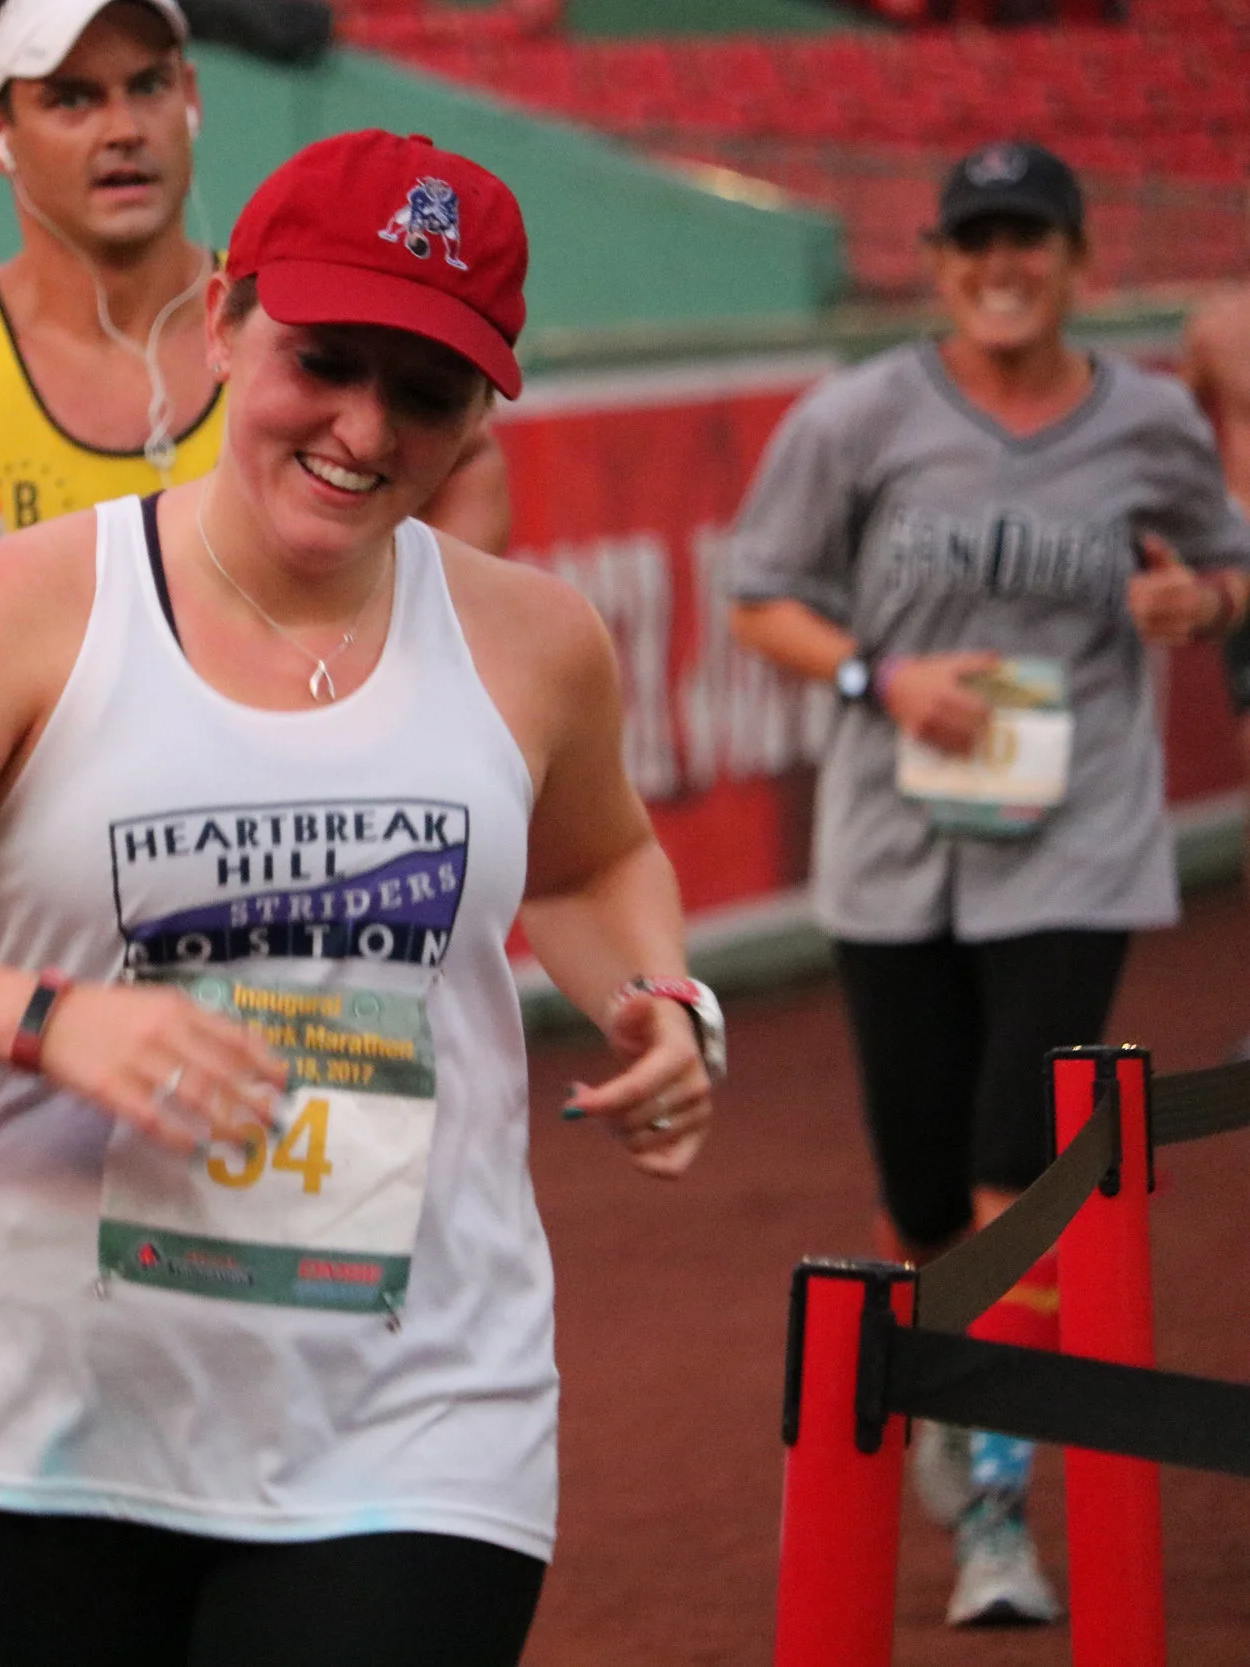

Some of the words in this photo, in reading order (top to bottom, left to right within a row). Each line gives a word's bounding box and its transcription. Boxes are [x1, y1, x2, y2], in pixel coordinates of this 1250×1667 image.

[124, 808, 451, 863] HEARTBREAK
[217, 847, 346, 887] HILL
[229, 863, 458, 926] STRIDERS
[233, 981, 342, 1017] Inaugural
[305, 1023, 415, 1062] Marathon
